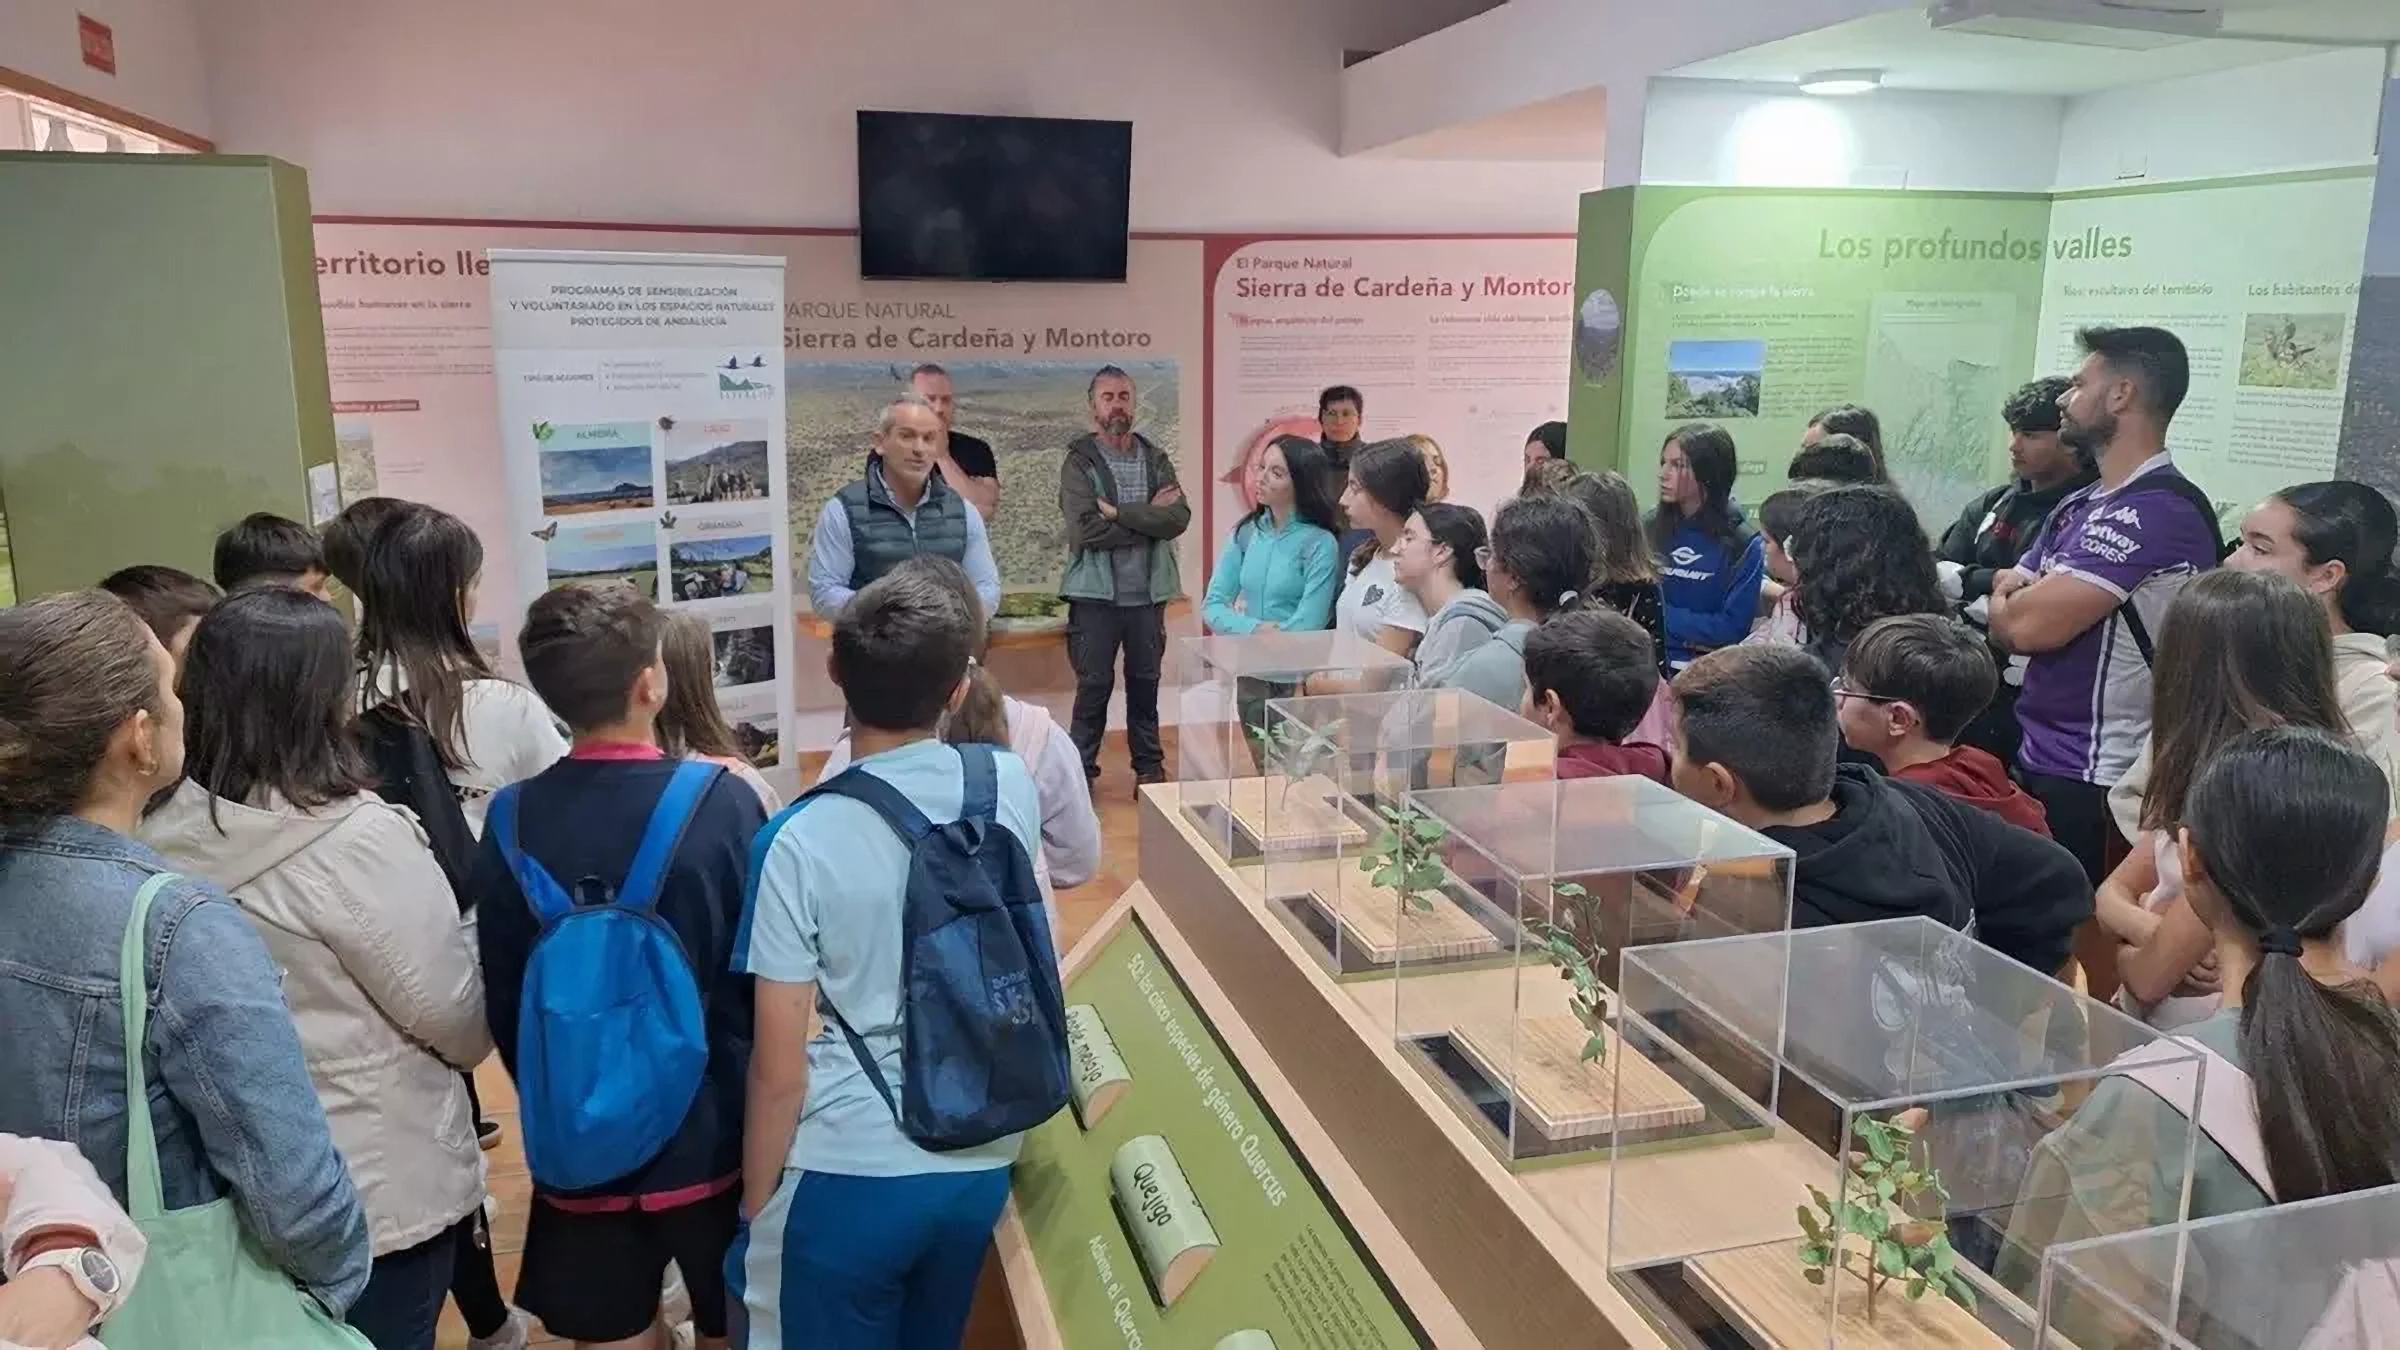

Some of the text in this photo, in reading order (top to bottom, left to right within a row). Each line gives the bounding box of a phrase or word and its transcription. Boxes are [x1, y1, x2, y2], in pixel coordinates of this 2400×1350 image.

[1819, 226, 2133, 268] Los profundos valles
[315, 250, 490, 275] erritorio lle
[1236, 257, 1352, 271] El Parque Natural
[551, 285, 625, 296] PROGRAMAS
[1236, 275, 1573, 302] Sierra de Cardeña y Montor
[2248, 284, 2269, 296] Los
[521, 300, 615, 311] VOLUNTARIADO
[865, 302, 957, 319] NATURAL
[784, 325, 1152, 354] Sierra de Cardeña y Montoro
[1203, 1086, 1244, 1140] género
[1241, 1134, 1287, 1207] Quercus
[1133, 1162, 1173, 1227] Quejigo
